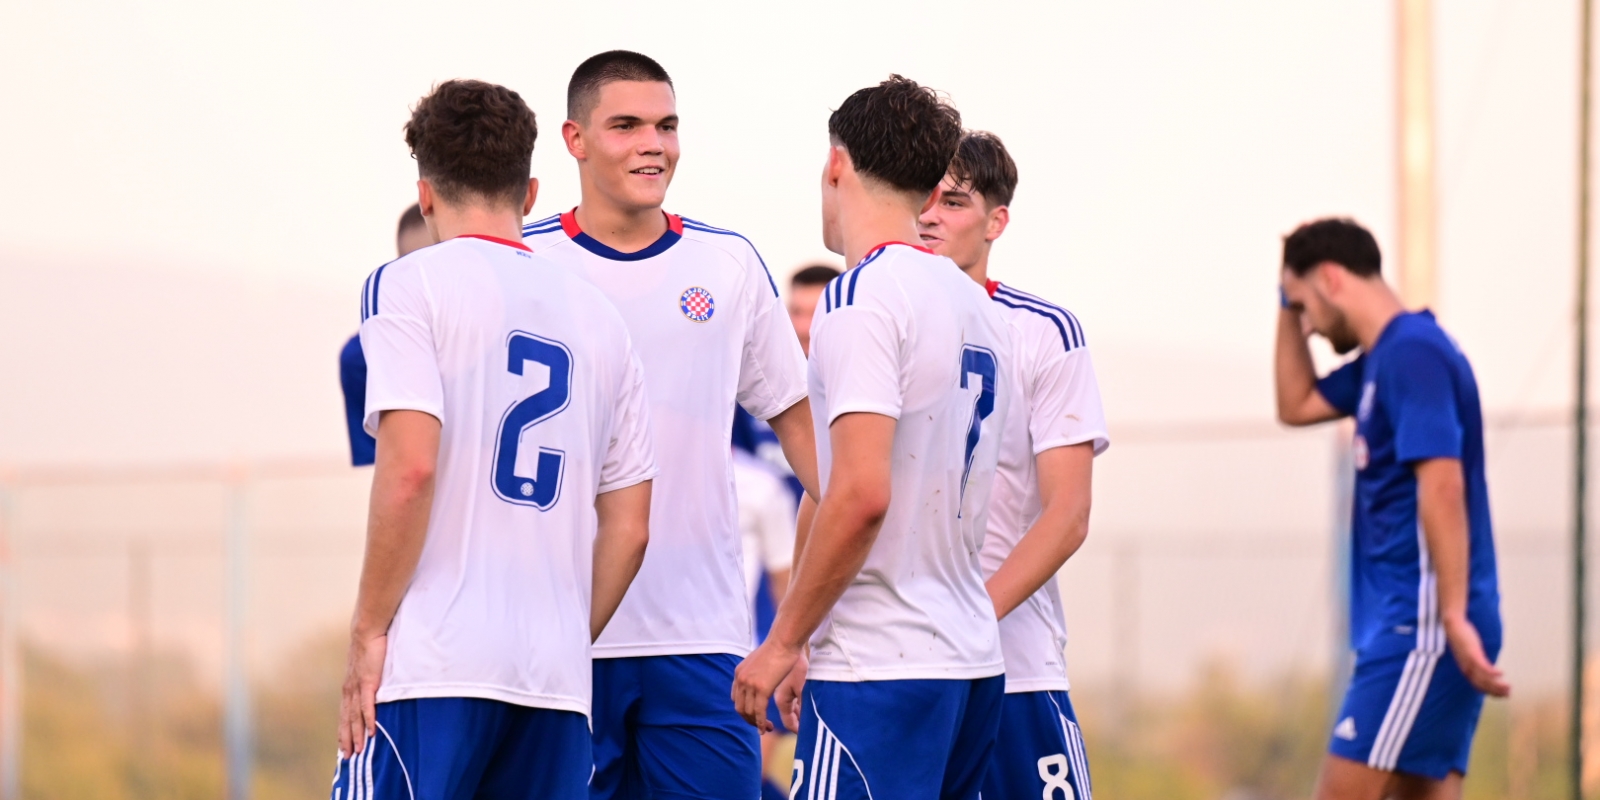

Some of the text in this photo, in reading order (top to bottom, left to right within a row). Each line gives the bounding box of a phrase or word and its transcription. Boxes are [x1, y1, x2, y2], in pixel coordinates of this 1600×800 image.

[683, 287, 711, 299] HAJDUK
[687, 311, 709, 321] SPLIT
[491, 329, 574, 512] 2
[959, 343, 998, 518] 7
[1037, 753, 1076, 800] 8
